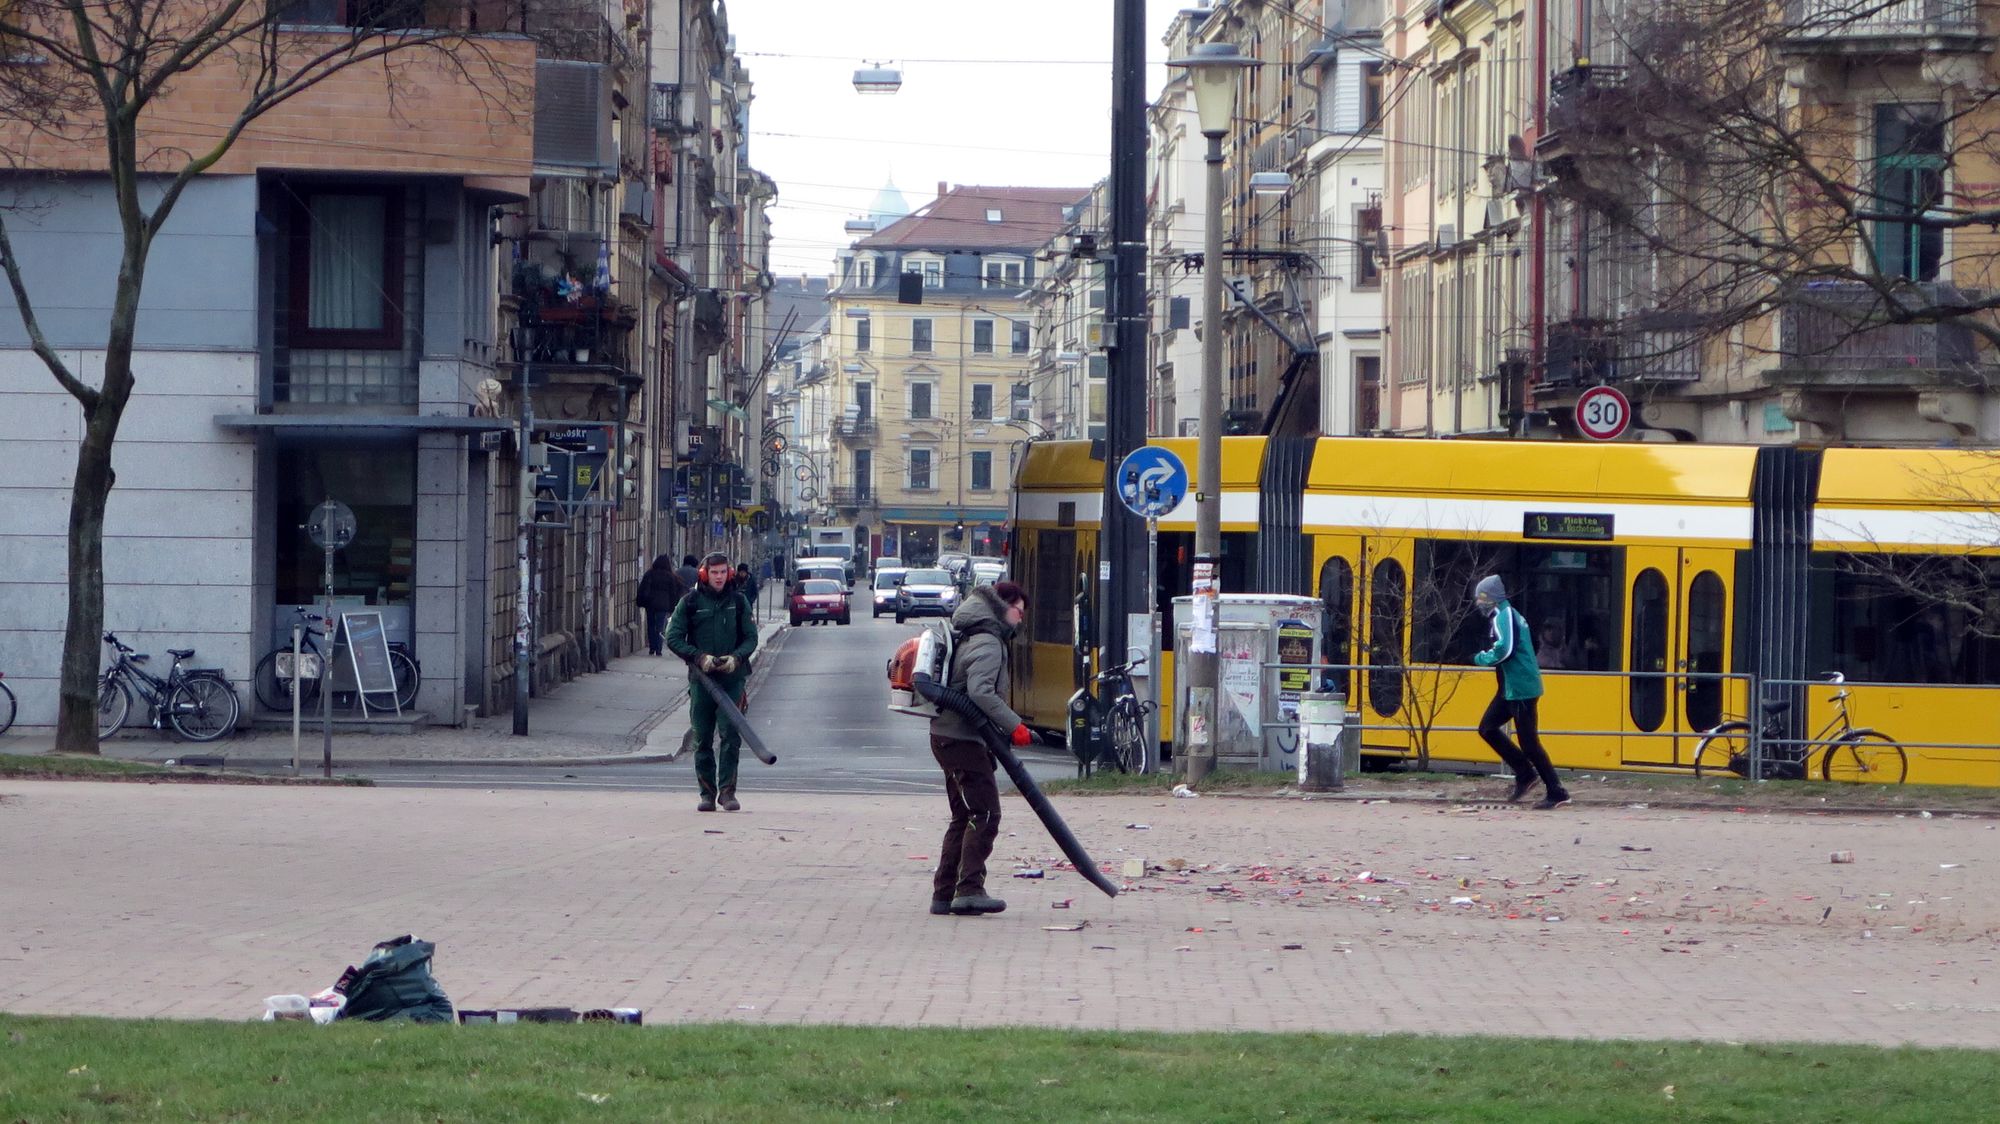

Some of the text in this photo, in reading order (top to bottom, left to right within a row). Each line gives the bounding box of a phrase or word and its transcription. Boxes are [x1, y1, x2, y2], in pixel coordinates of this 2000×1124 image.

[1233, 281, 1244, 301] E
[1588, 402, 1618, 425] 30
[1536, 515, 1549, 532] 13
